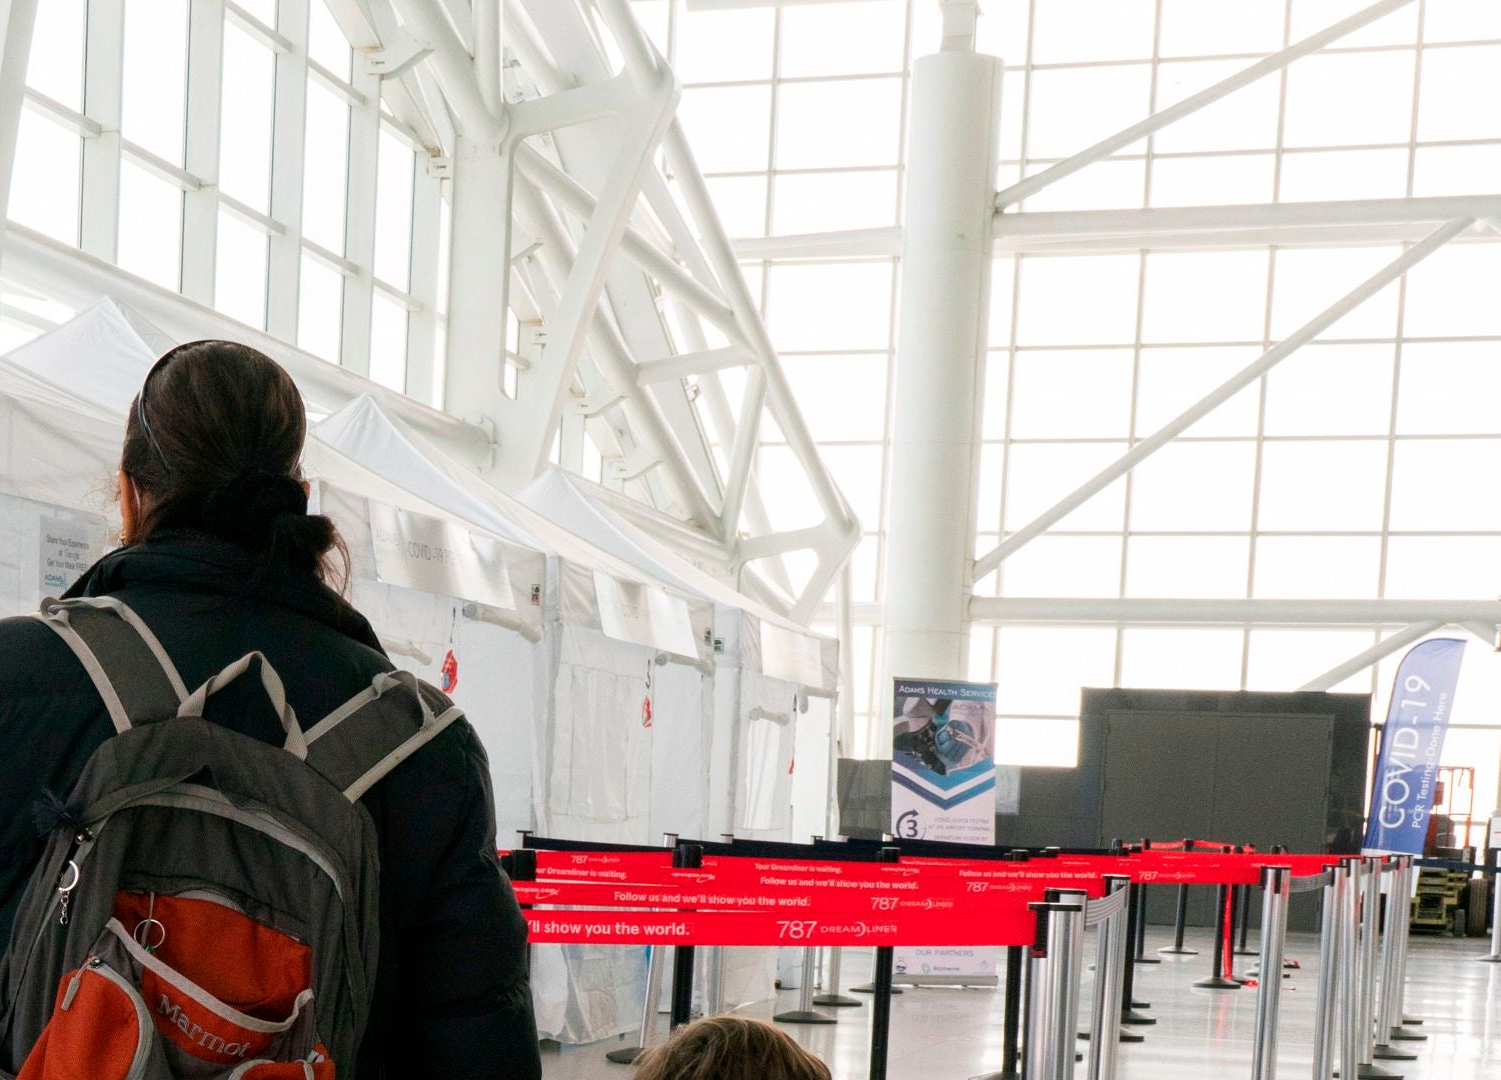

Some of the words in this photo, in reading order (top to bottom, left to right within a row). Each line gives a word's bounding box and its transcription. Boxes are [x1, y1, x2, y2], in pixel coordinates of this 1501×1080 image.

[899, 685, 925, 694] ADAMS
[928, 687, 957, 696] HEALTH
[1412, 805, 1425, 828] PCR
[1435, 692, 1447, 722] Here
[906, 819, 918, 838] 3
[760, 876, 786, 885] Follow
[788, 878, 797, 886] us
[799, 878, 814, 887] and
[836, 880, 858, 888] show
[859, 881, 874, 889] you
[876, 881, 890, 889] the
[966, 882, 988, 892] 787
[614, 891, 646, 901] Follow
[649, 894, 660, 903] us
[662, 894, 680, 903] and
[682, 894, 706, 904] we'll
[708, 896, 735, 905] show
[737, 896, 756, 907] you
[758, 896, 775, 906] the
[870, 897, 898, 910] 787
[544, 922, 580, 934] show
[585, 923, 610, 937] you
[615, 922, 639, 934] the
[644, 922, 690, 936] world.
[776, 920, 817, 939] 787
[157, 994, 251, 1057] Marmot
